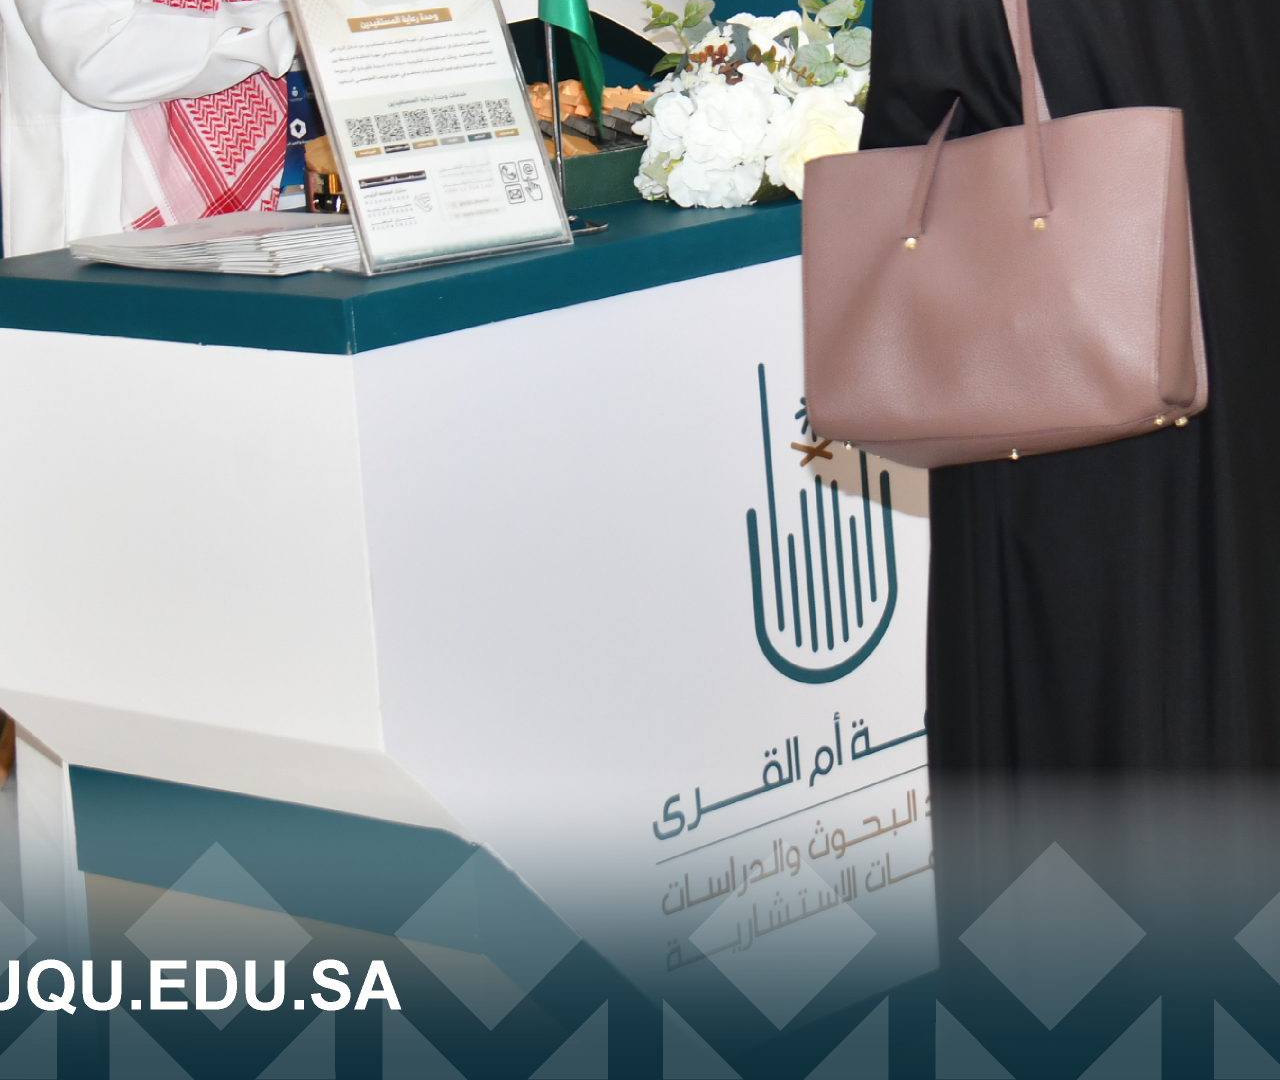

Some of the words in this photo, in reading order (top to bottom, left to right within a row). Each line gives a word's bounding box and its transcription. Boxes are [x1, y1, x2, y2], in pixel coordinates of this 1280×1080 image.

[419, 12, 439, 21] وحدة
[809, 711, 843, 787] أم
[652, 735, 802, 841] القرى
[808, 788, 917, 860] البحوث
[661, 838, 801, 916] والدراسات
